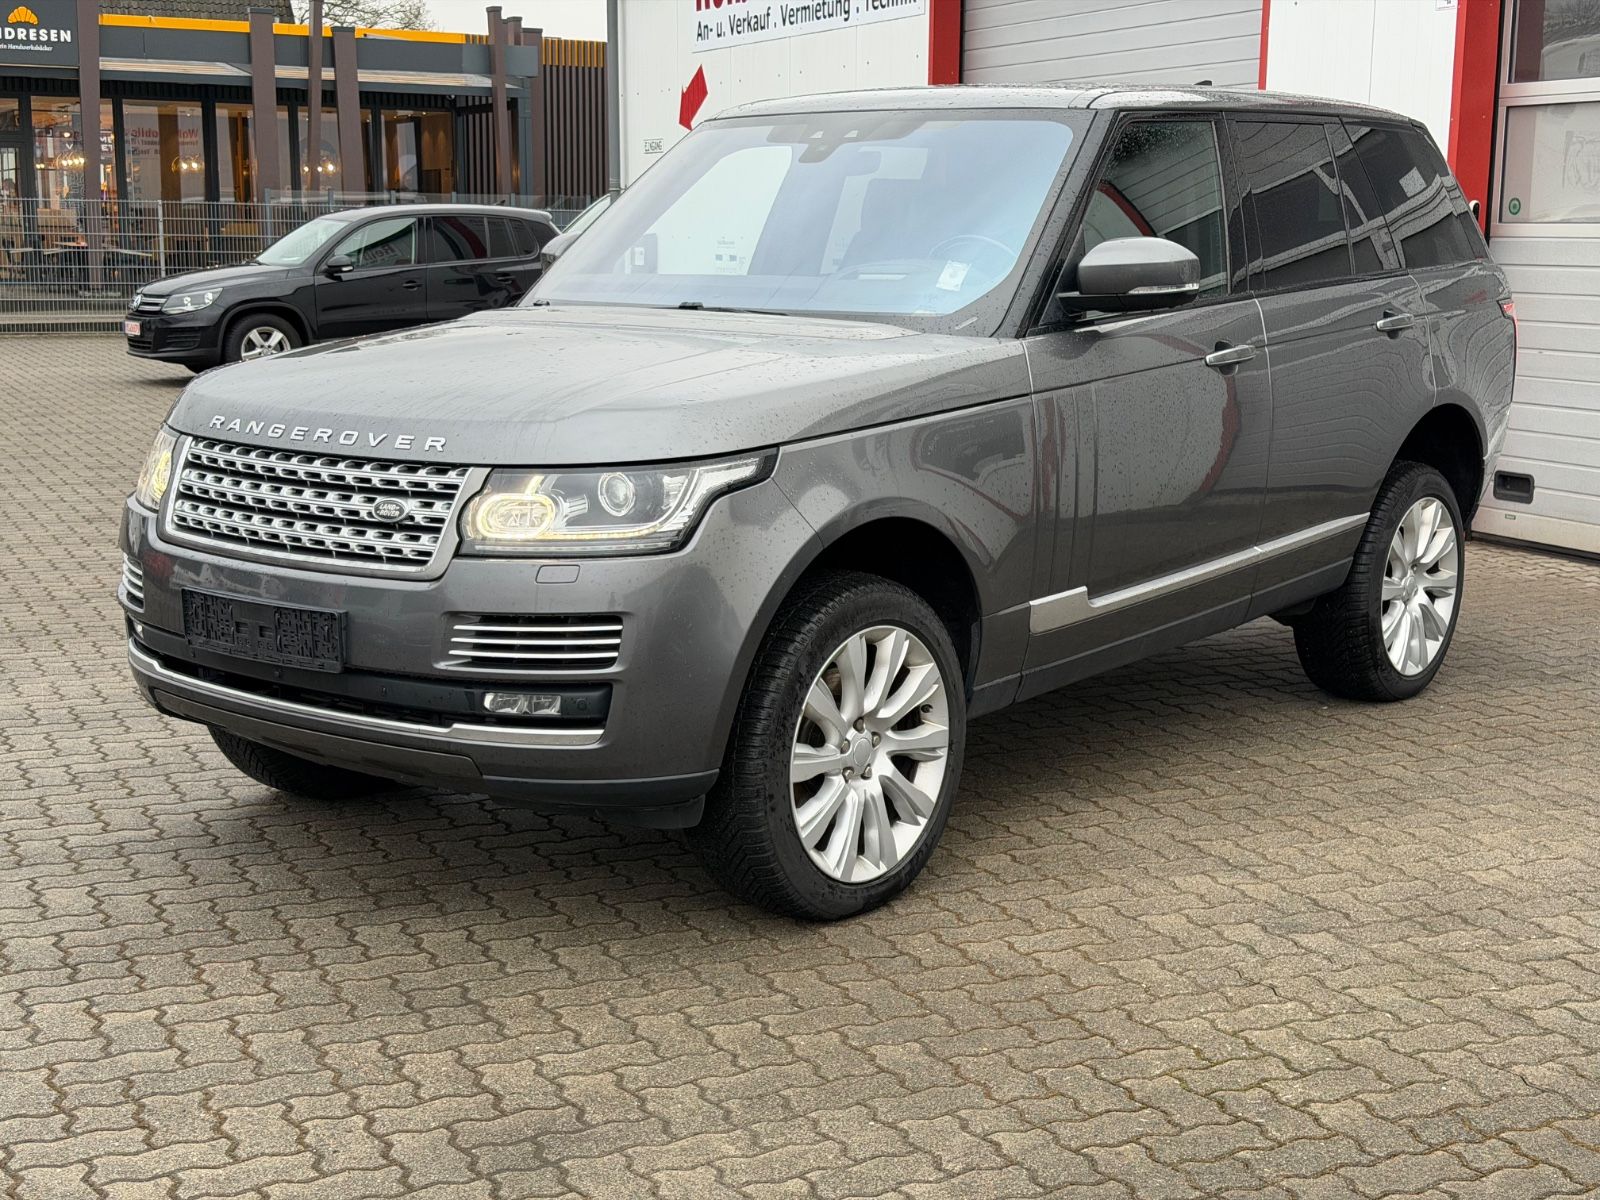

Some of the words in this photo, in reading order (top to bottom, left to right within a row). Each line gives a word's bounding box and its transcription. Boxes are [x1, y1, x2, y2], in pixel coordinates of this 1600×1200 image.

[0, 27, 71, 42] DRESEN
[696, 20, 713, 41] An-
[717, 21, 726, 38] u.
[728, 6, 771, 36] Verkauf
[780, 0, 851, 27] Vermietung
